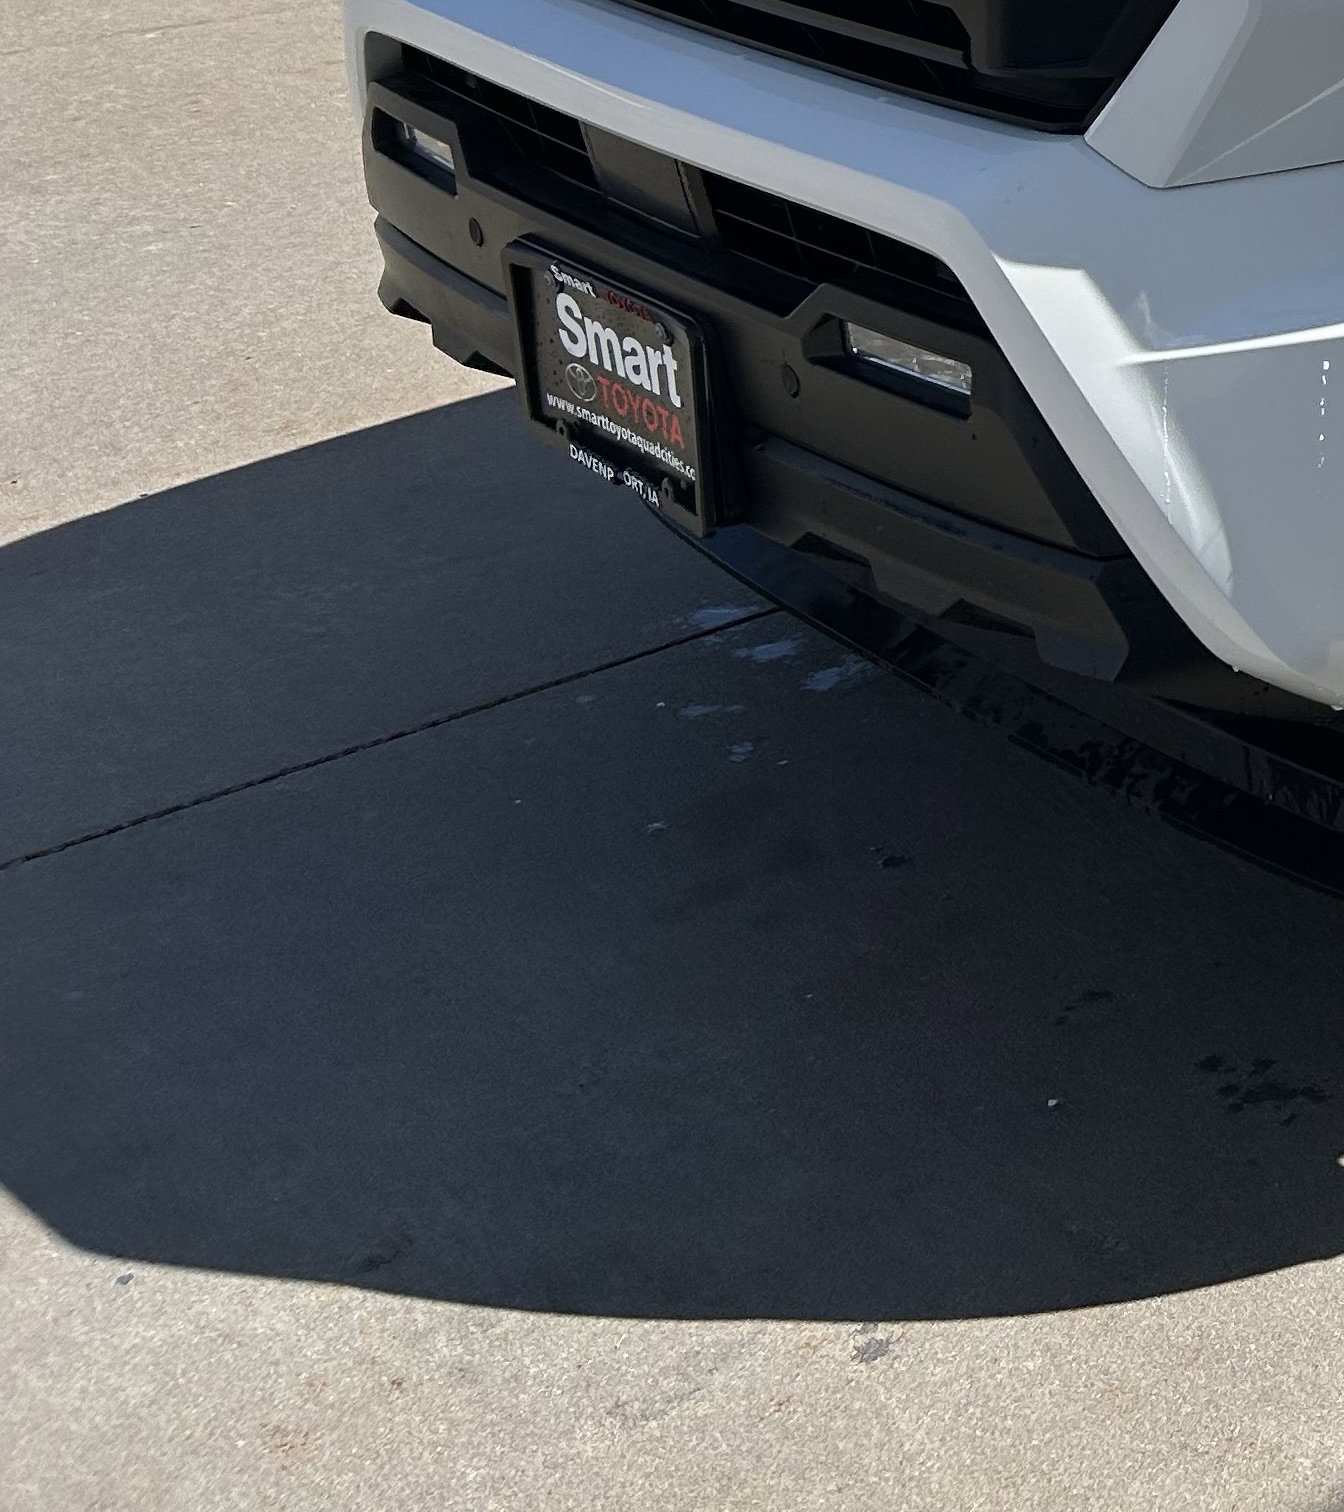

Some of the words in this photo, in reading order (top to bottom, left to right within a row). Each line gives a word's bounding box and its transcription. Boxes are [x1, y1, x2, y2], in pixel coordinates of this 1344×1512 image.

[550, 264, 597, 298] Smart
[556, 292, 682, 408] Smart
[597, 375, 686, 450] TOYOTA
